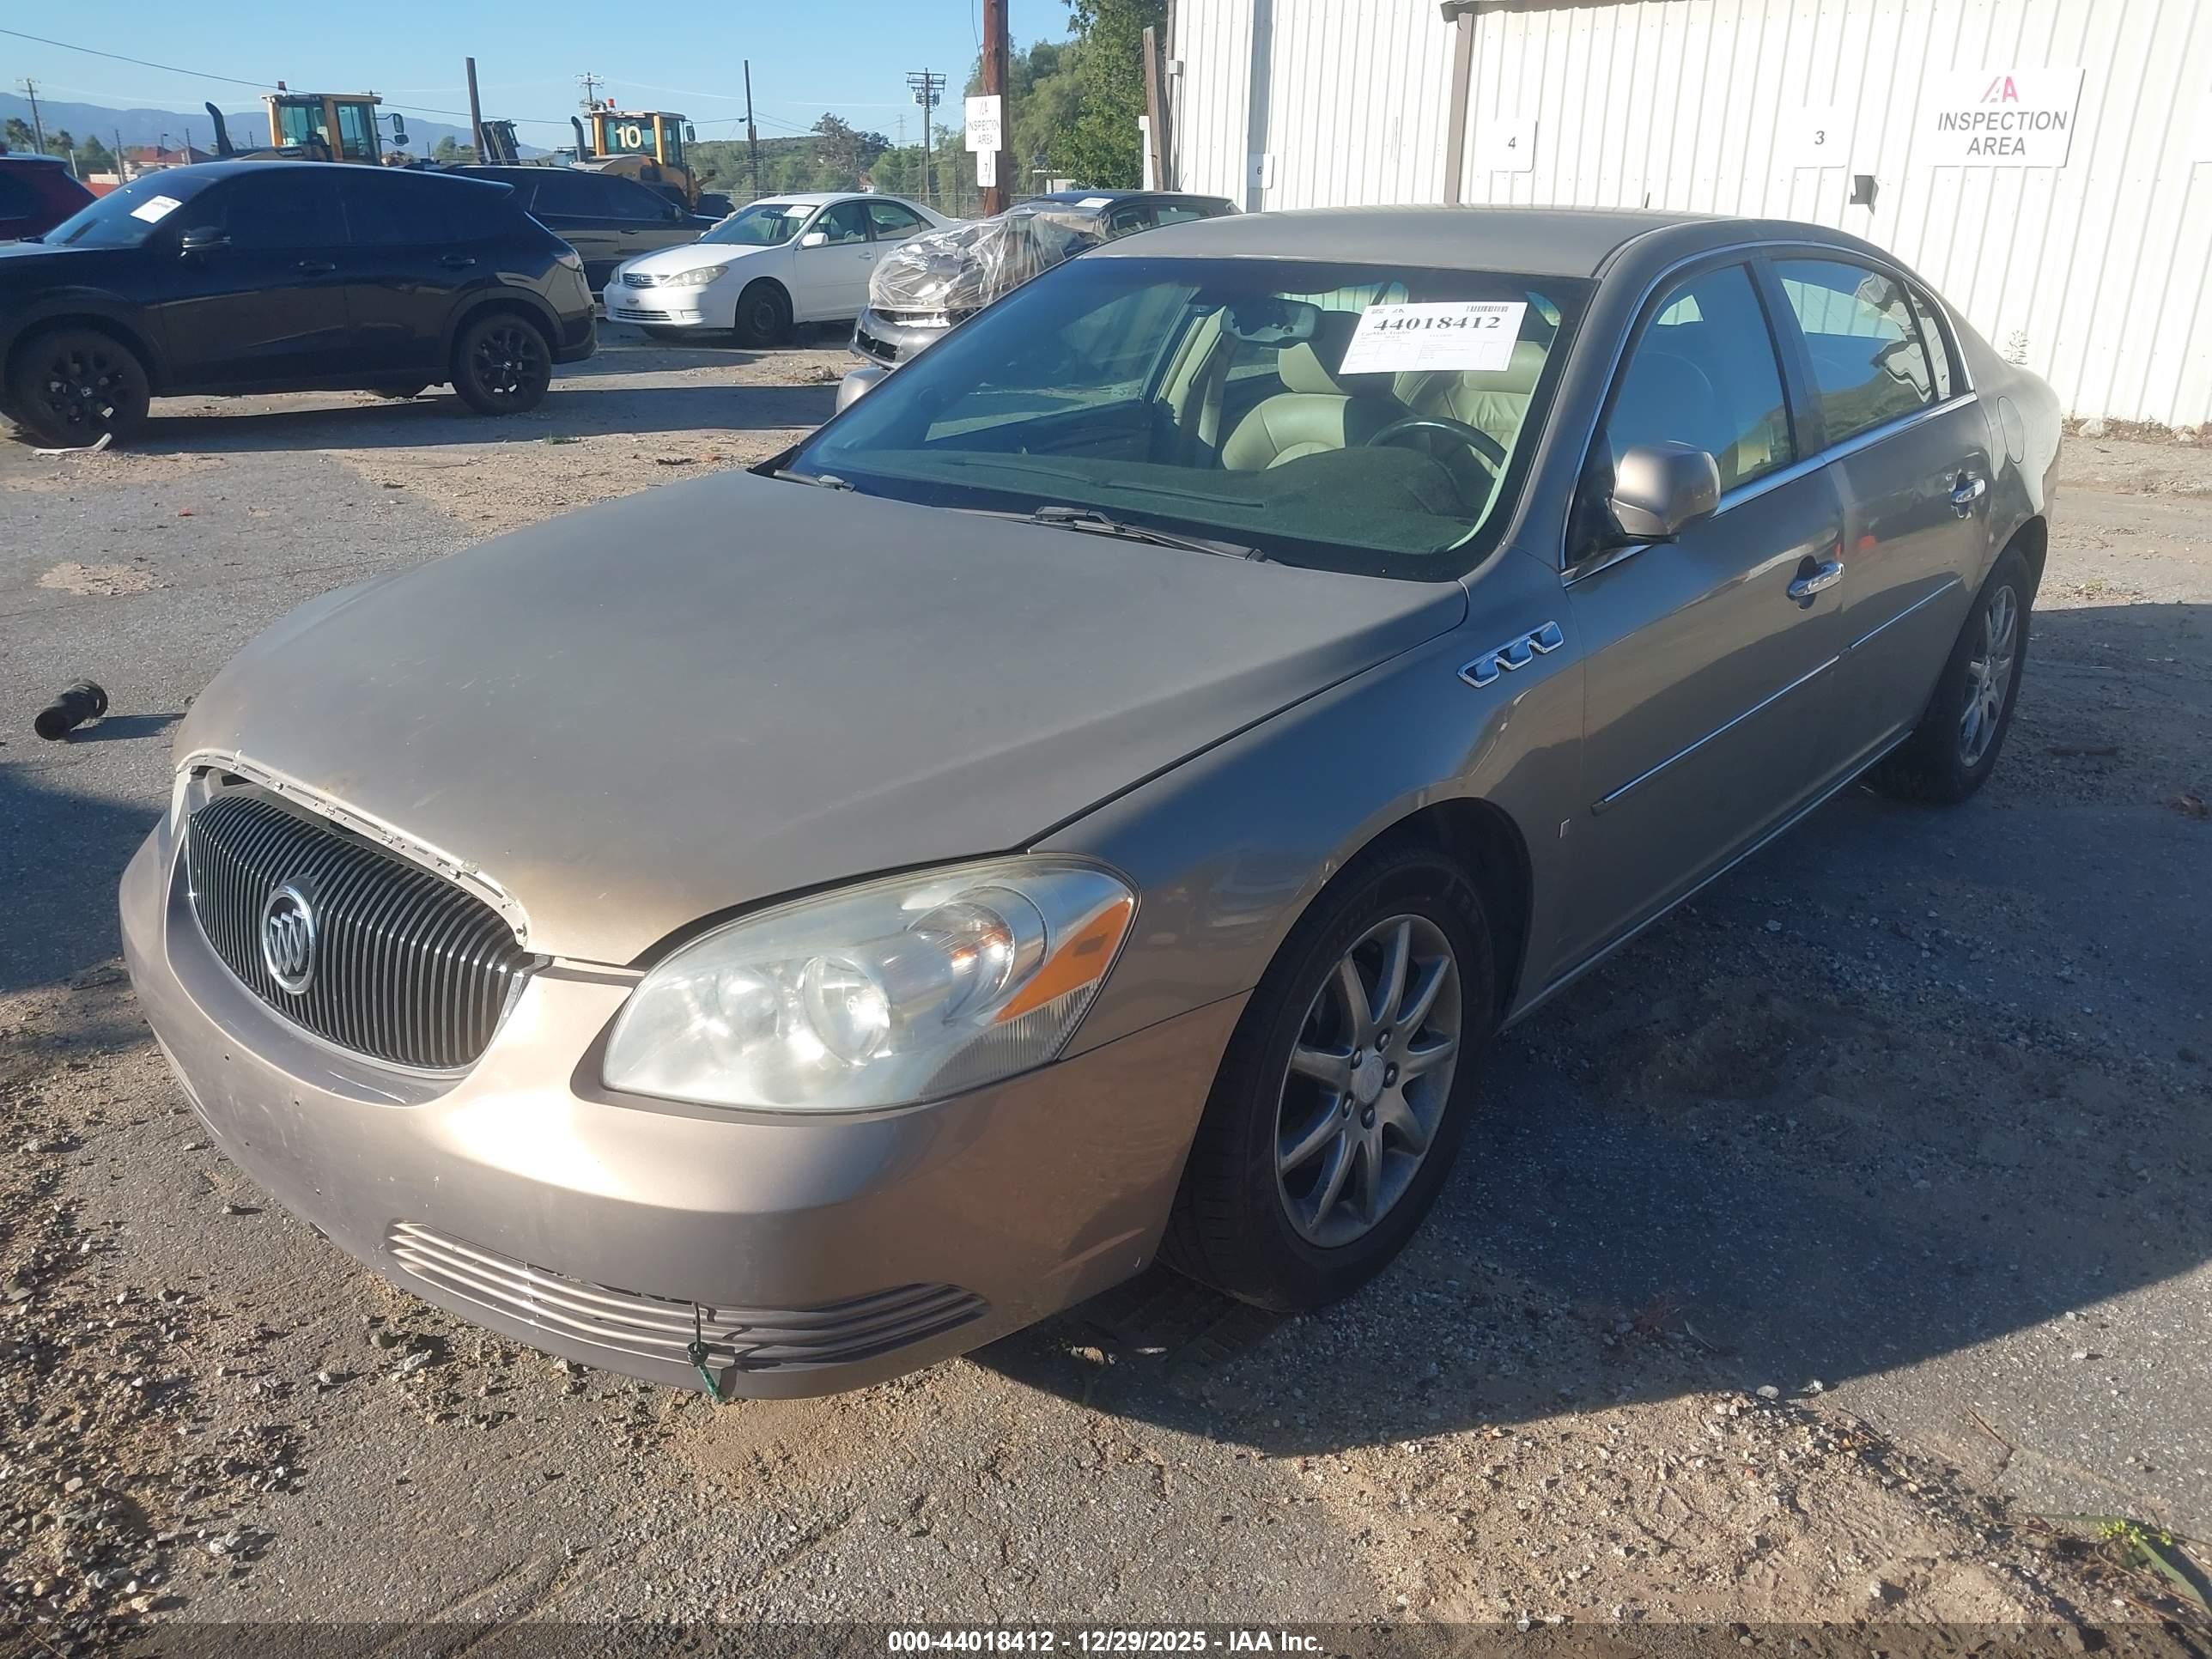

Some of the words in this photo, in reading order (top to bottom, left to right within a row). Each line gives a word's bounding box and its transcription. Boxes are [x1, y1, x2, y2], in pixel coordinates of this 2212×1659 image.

[967, 119, 1000, 131] INSPECTION
[1937, 111, 2068, 131] INSPECTION
[615, 125, 642, 149] 10
[1507, 136, 1516, 150] 4
[1814, 130, 1826, 145] 3
[1966, 137, 2027, 156] AREA
[1256, 166, 1263, 176] 6
[1374, 316, 1501, 331] 44018412
